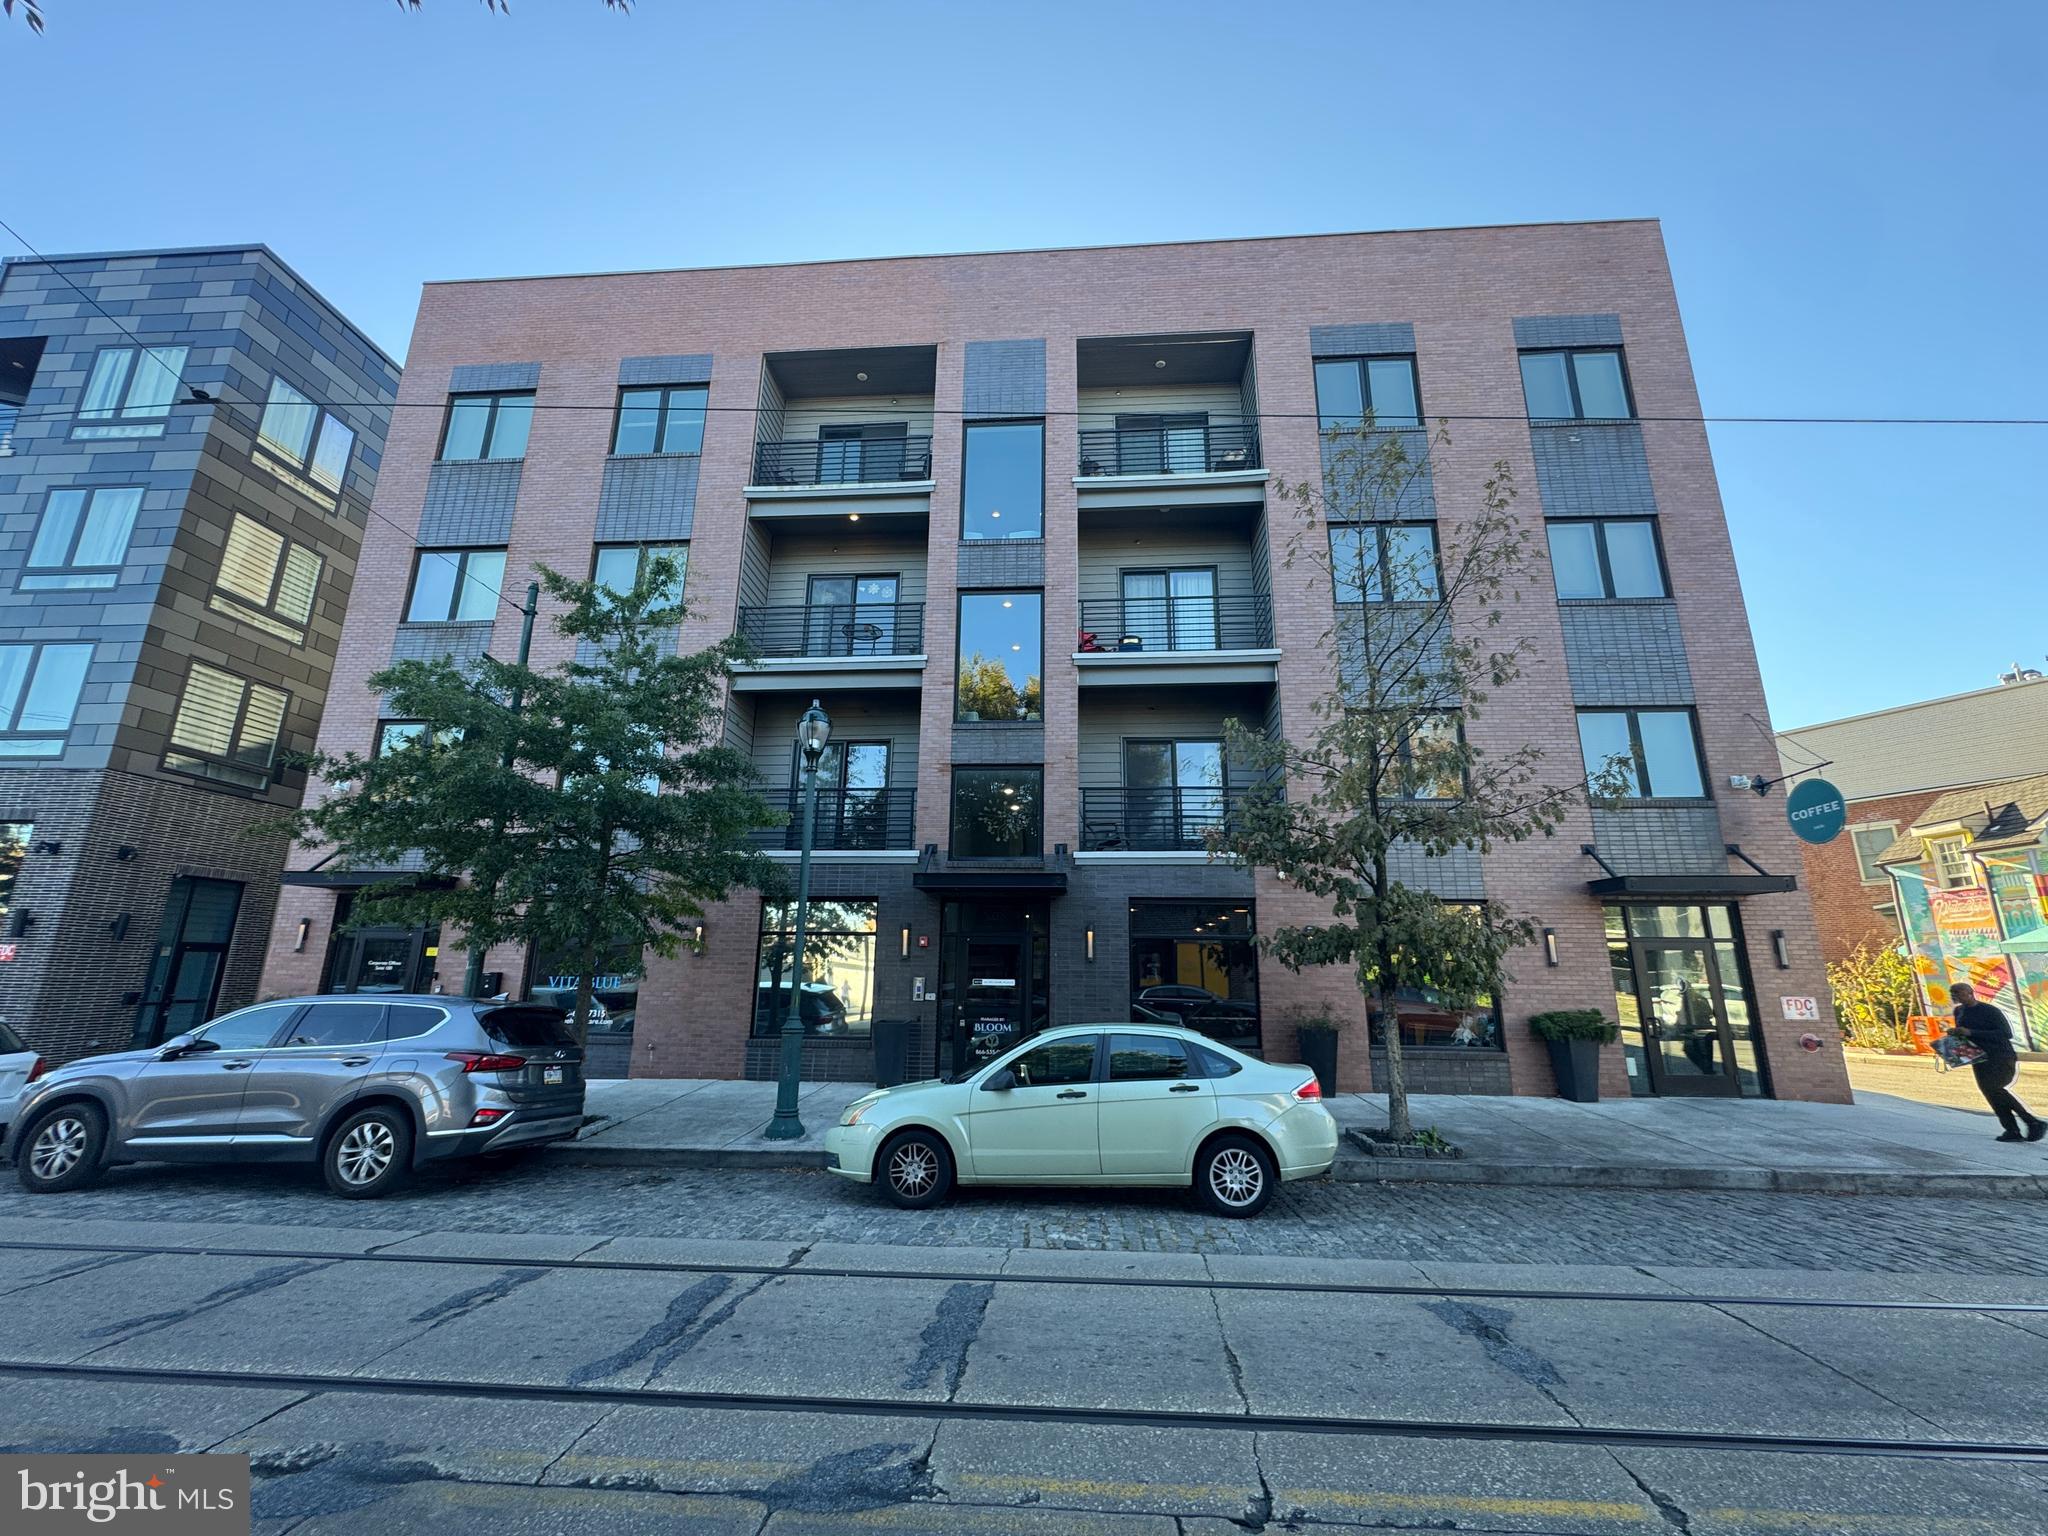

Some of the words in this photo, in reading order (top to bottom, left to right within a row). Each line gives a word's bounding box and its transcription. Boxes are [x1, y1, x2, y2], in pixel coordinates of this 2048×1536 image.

[1791, 801, 1840, 821] COFFEE
[1786, 999, 1813, 1011] FDC
[974, 1023, 1012, 1032] BLOOM
